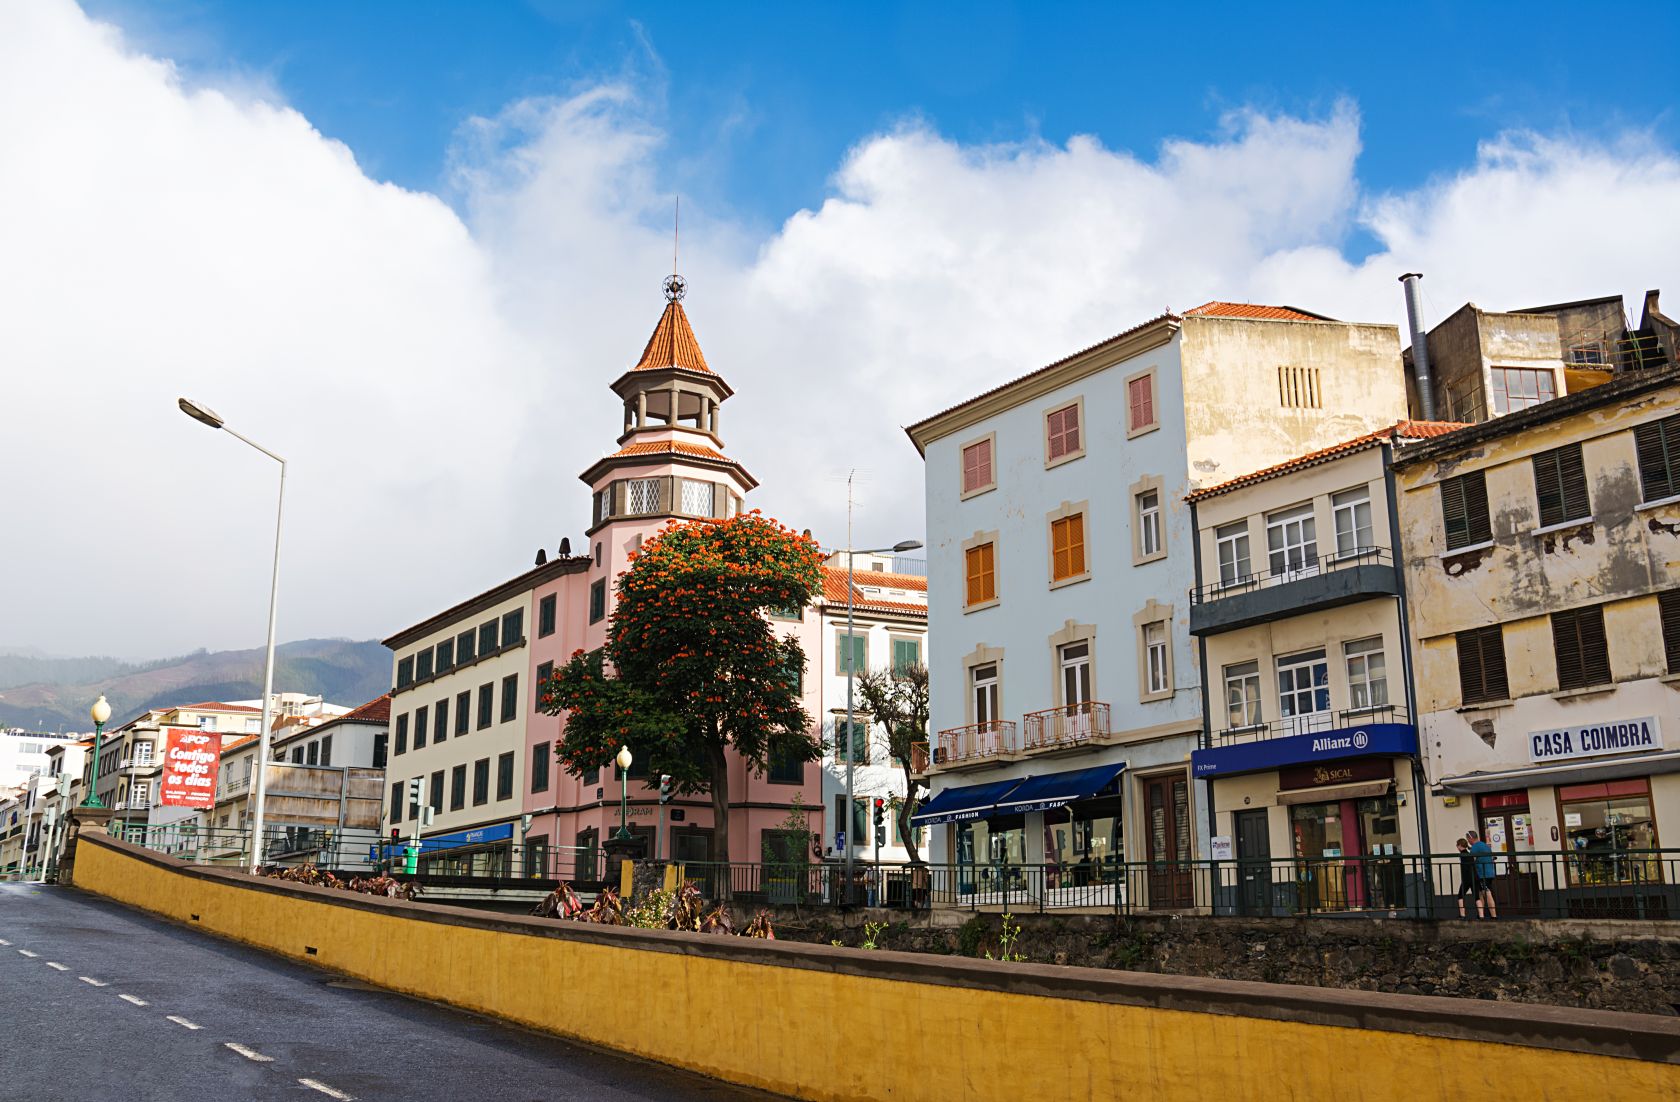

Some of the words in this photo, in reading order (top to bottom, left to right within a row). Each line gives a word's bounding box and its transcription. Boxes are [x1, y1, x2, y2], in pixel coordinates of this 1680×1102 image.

[188, 735, 210, 745] PCP
[1312, 737, 1352, 752] Allianz
[1533, 731, 1573, 757] CASA
[1580, 721, 1652, 751] COIMBRA
[170, 747, 216, 764] Contigo
[174, 760, 209, 774] todos
[1330, 768, 1353, 779] SICAL
[167, 775, 183, 785] os
[184, 773, 212, 787] dias
[955, 811, 979, 820] FASHION
